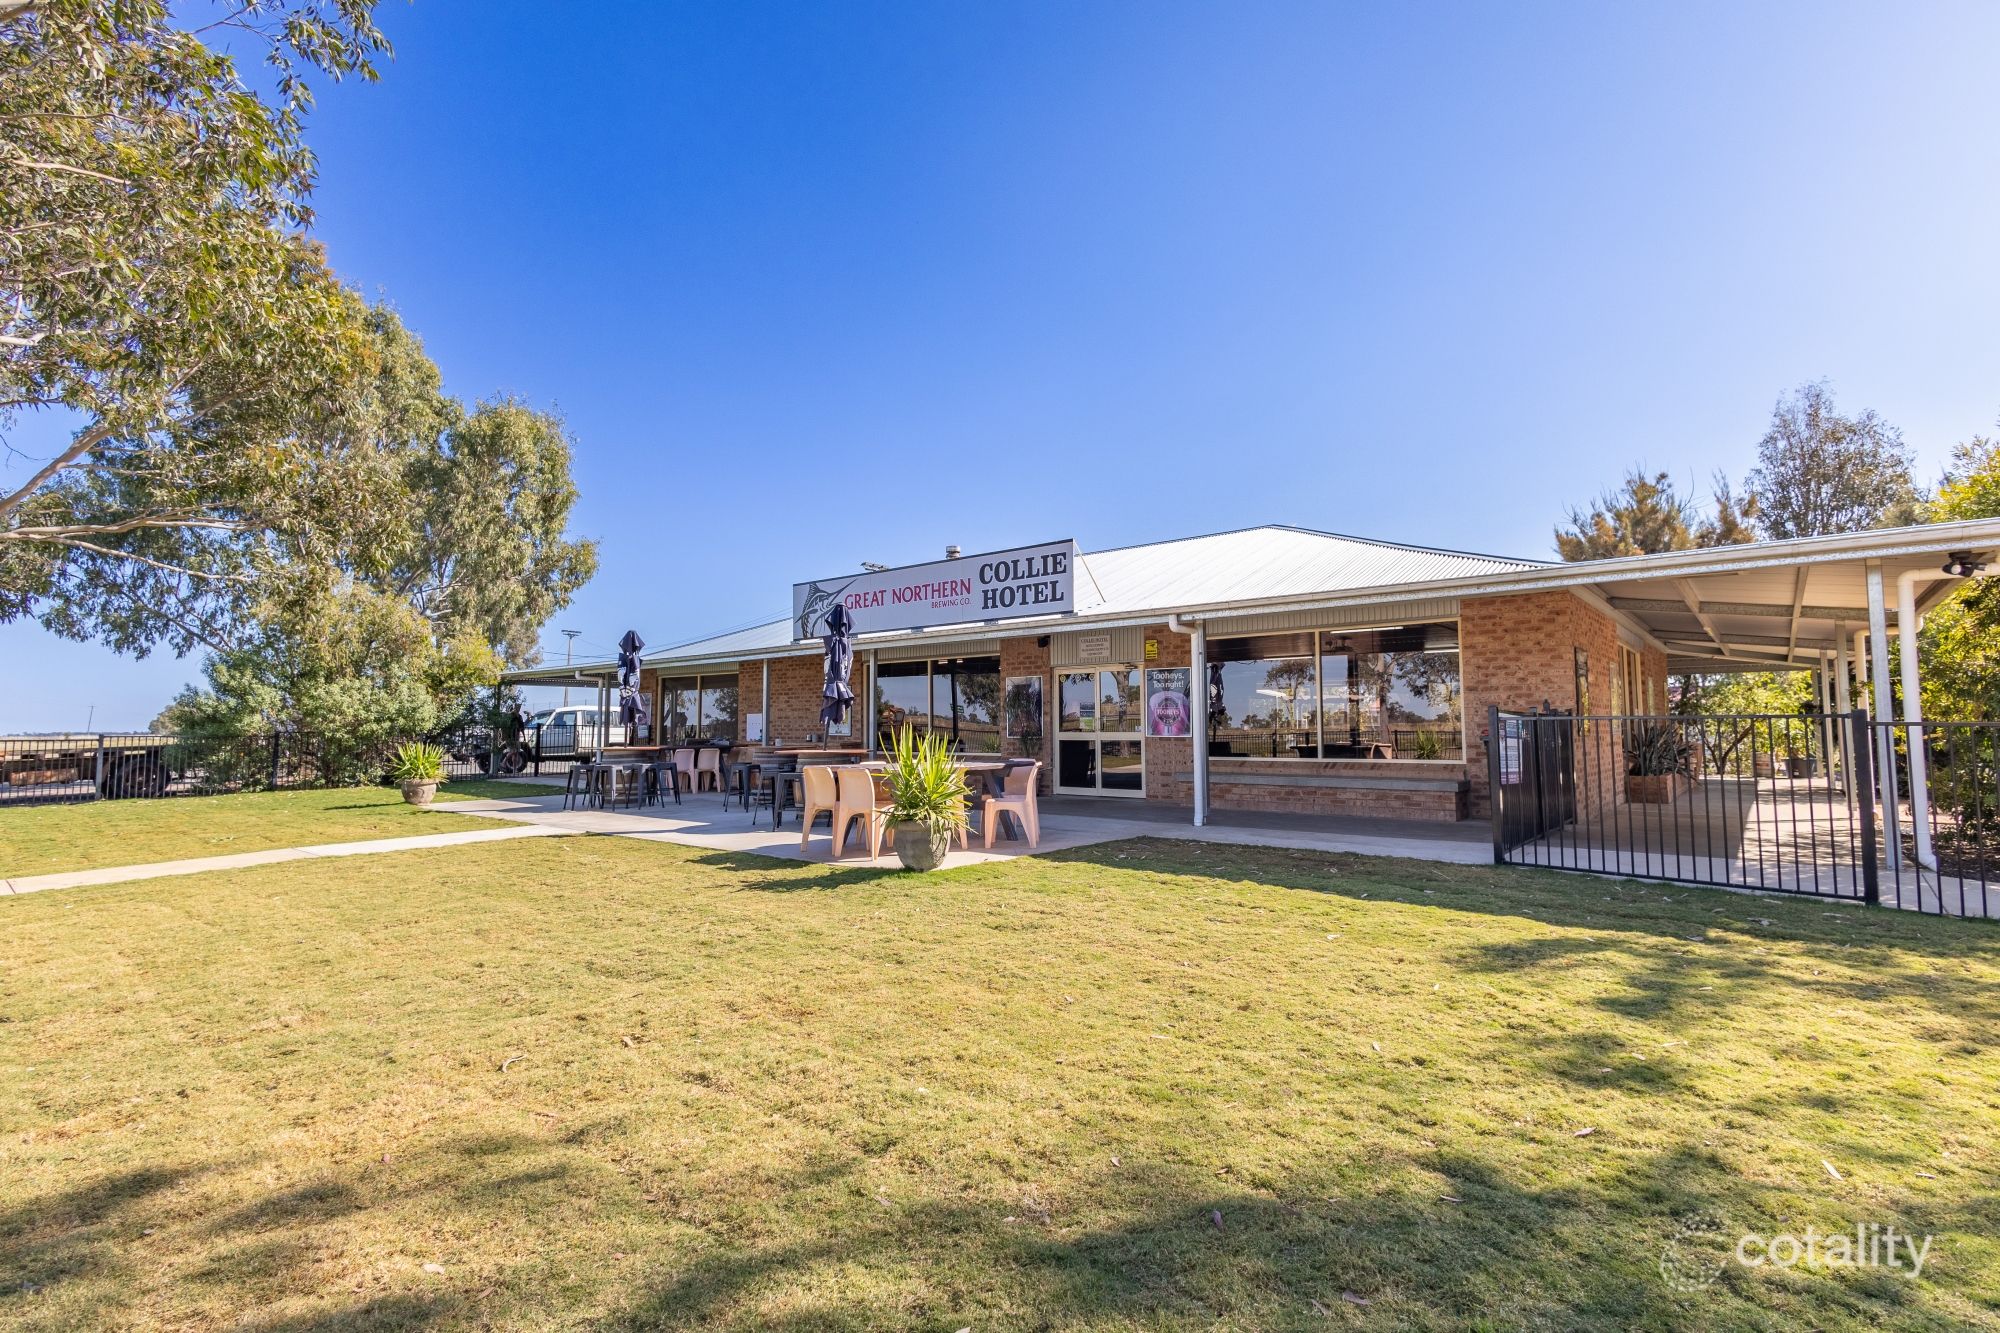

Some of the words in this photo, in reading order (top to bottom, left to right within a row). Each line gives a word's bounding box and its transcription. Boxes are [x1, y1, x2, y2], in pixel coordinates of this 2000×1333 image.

[979, 552, 1067, 585] COLLIE
[844, 590, 887, 610] GREAT
[892, 578, 971, 605] NORTHERN
[931, 598, 959, 609] BREWING
[959, 597, 972, 606] CO.
[982, 580, 1064, 610] HOTEL
[1152, 671, 1185, 680] Tooheys.
[1153, 680, 1165, 688] Too
[1165, 680, 1184, 690] right!
